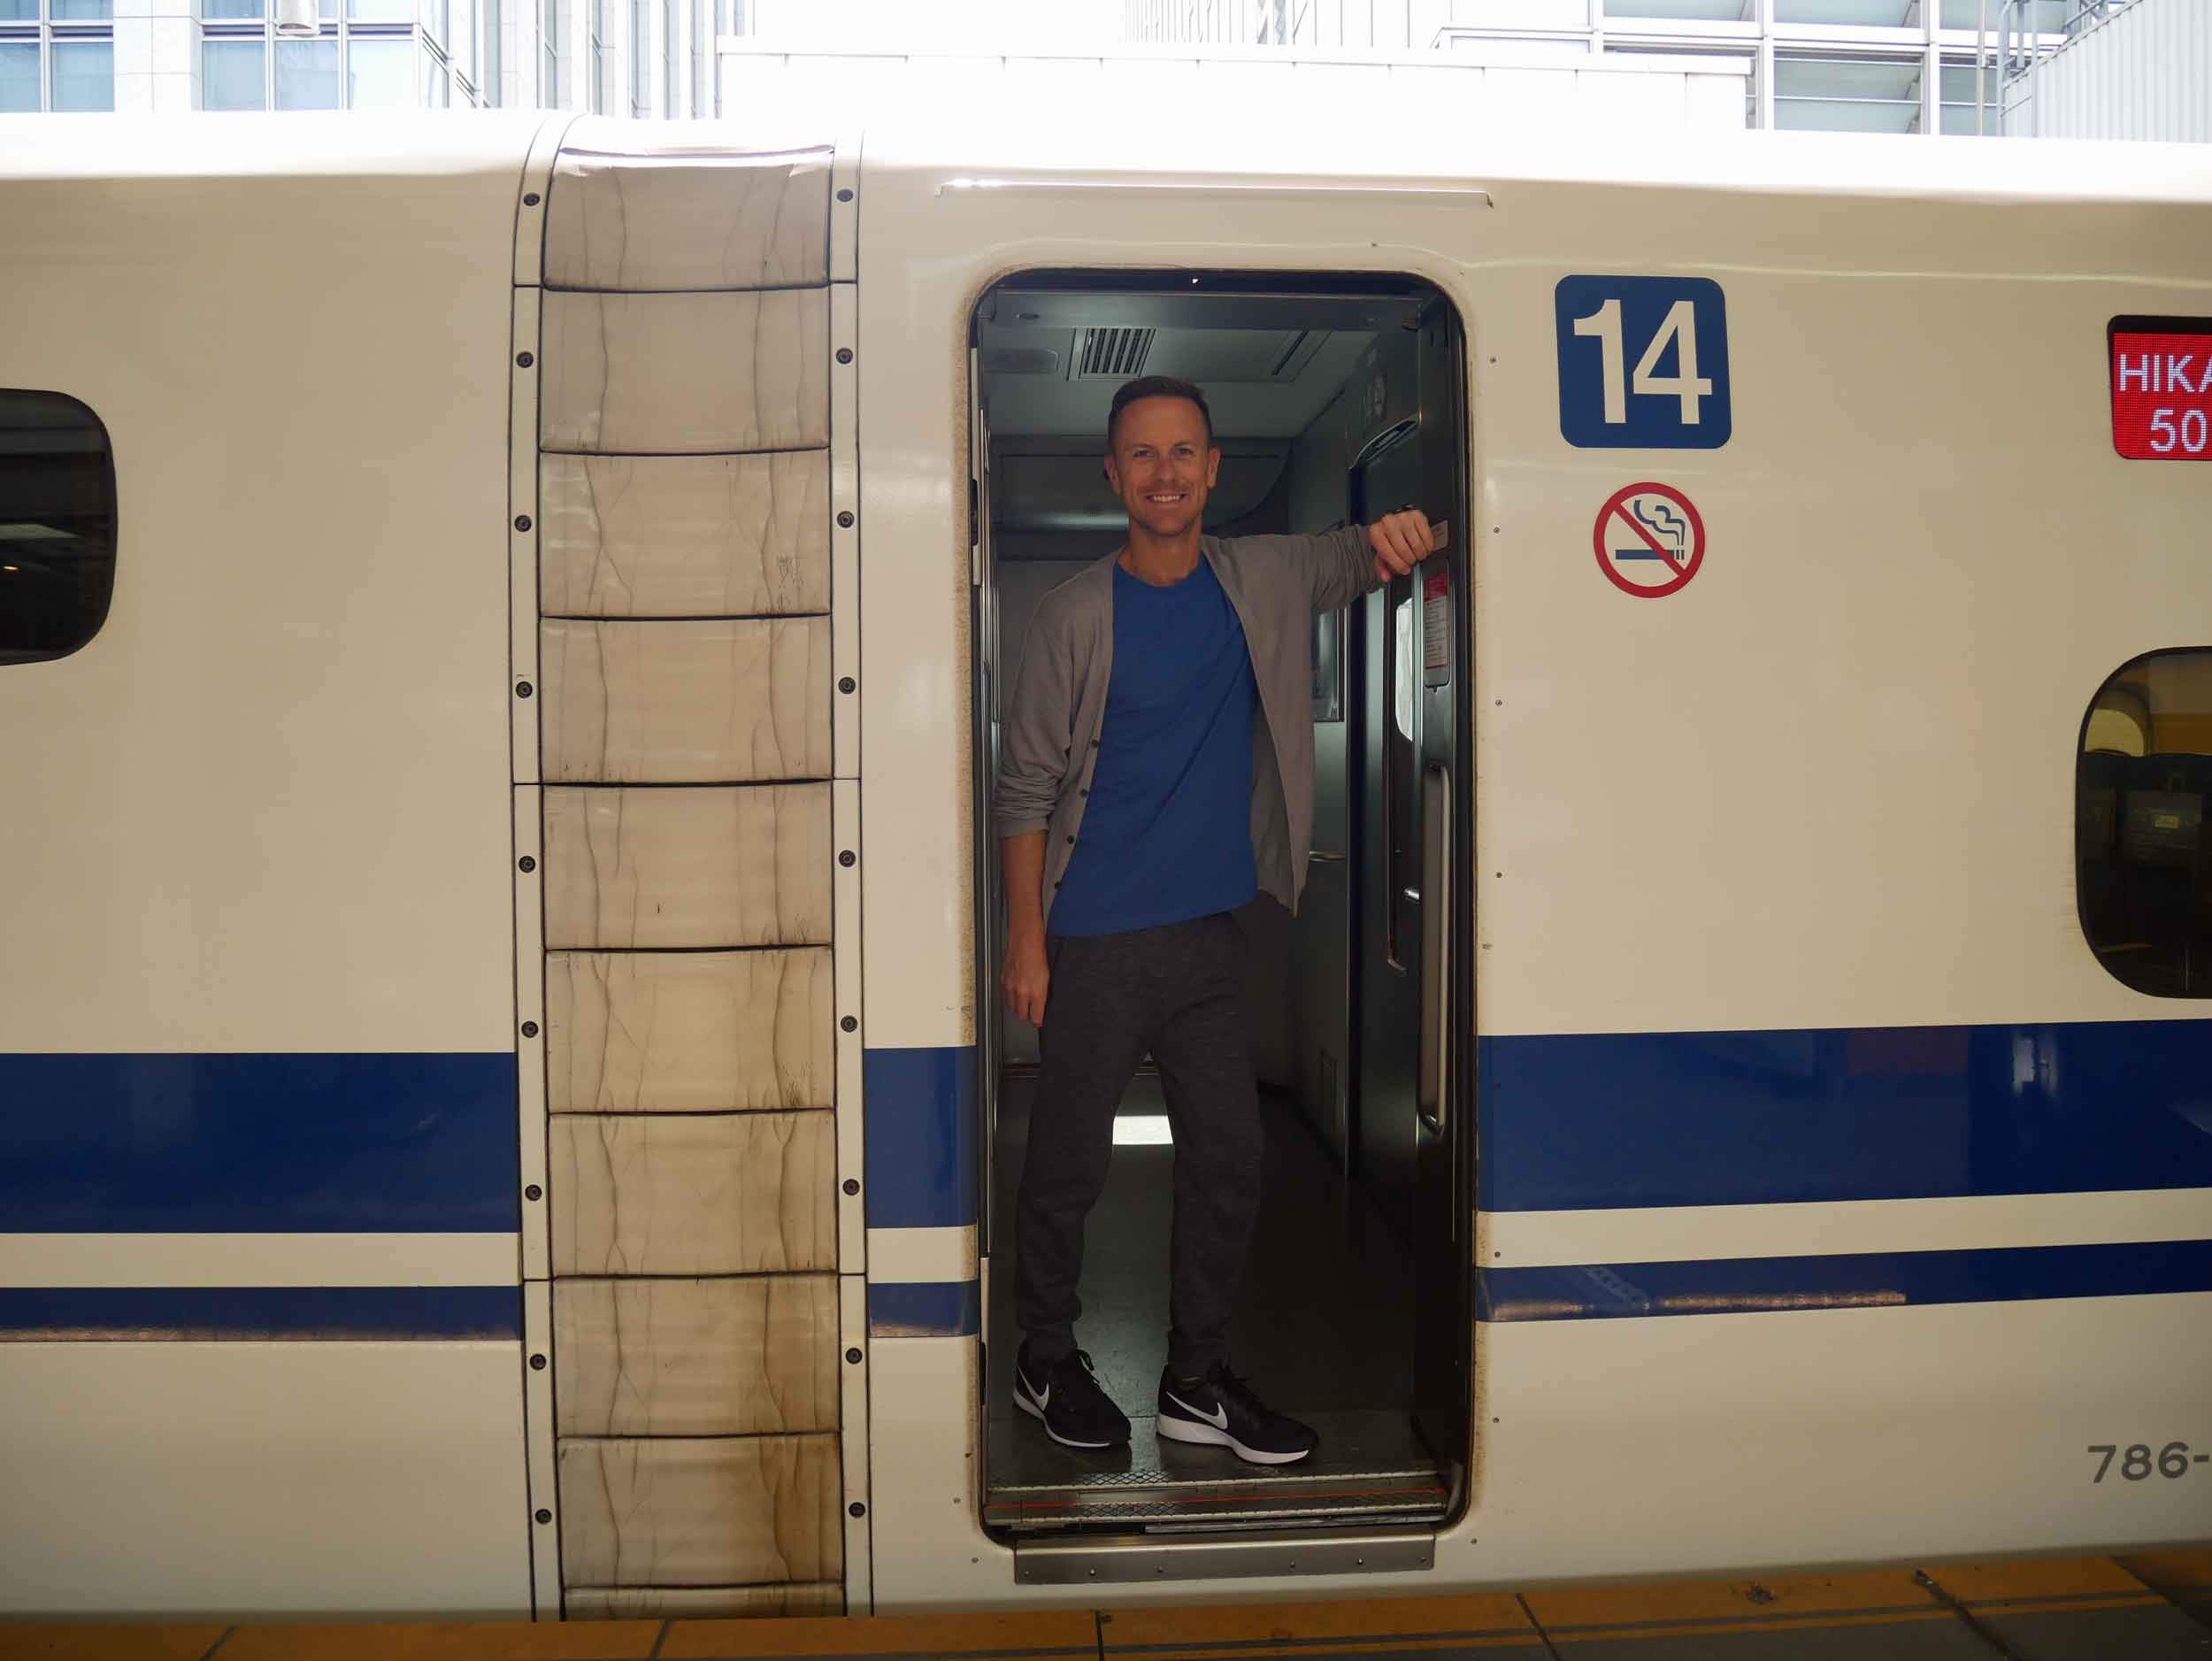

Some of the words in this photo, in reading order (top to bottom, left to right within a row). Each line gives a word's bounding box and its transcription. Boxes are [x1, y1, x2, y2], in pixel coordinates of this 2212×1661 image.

[1573, 298, 1713, 425] 14
[2150, 409, 2208, 453] 50
[2087, 1441, 2210, 1484] 786-
